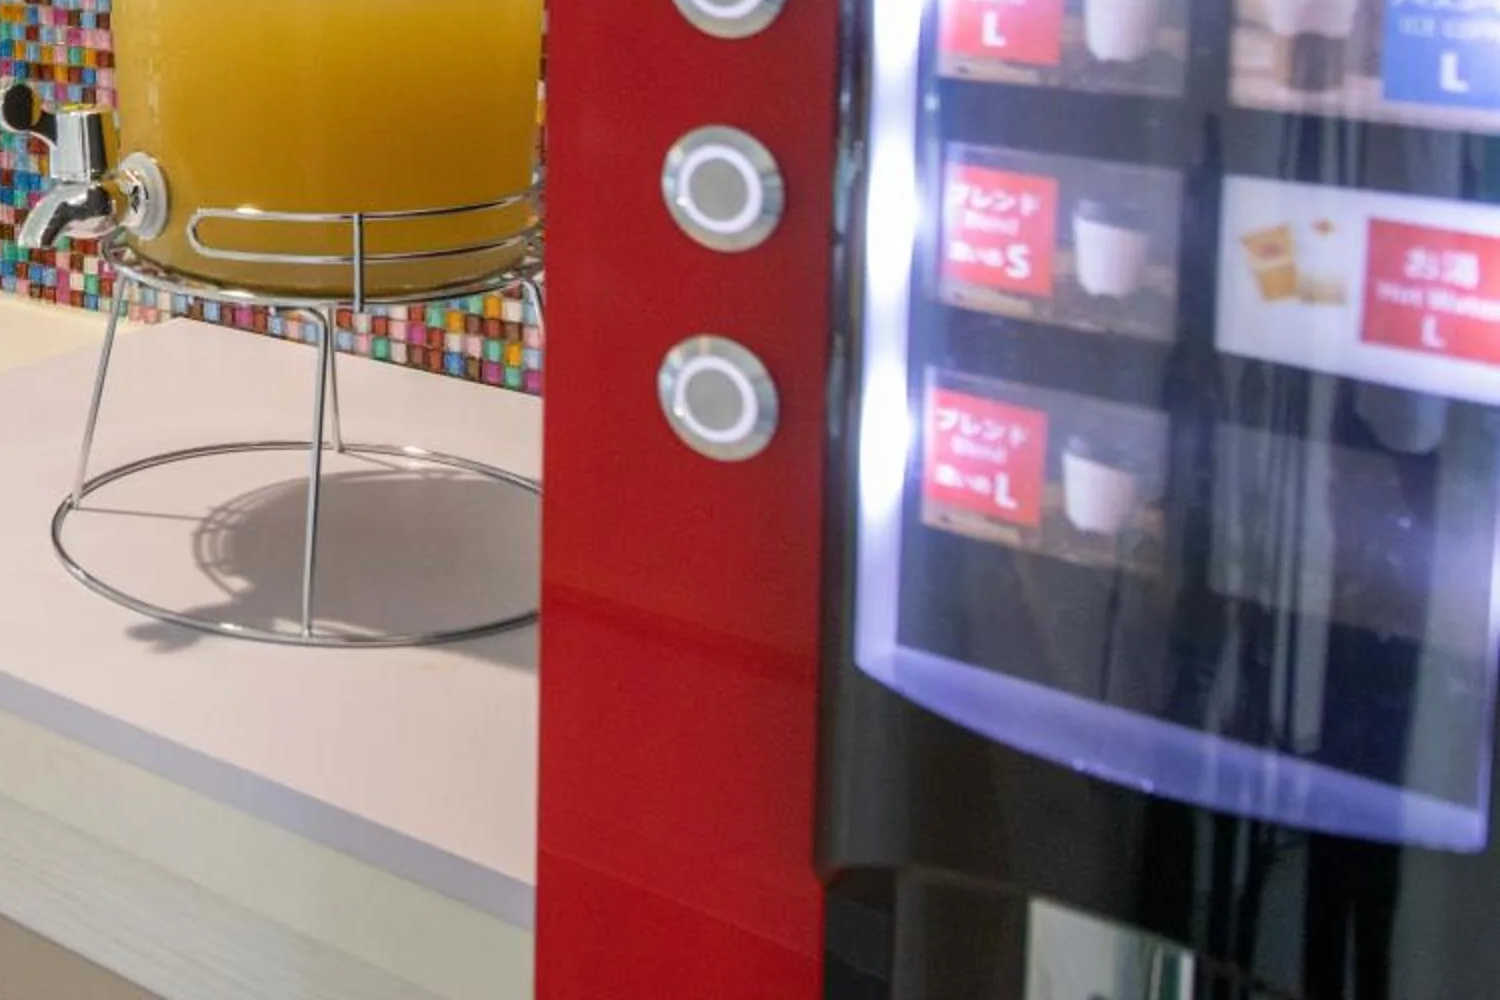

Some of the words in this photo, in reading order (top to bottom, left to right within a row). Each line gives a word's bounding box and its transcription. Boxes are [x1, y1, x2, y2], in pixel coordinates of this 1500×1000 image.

[982, 10, 1007, 48] L
[1440, 50, 1471, 95] L
[1421, 314, 1448, 350] L
